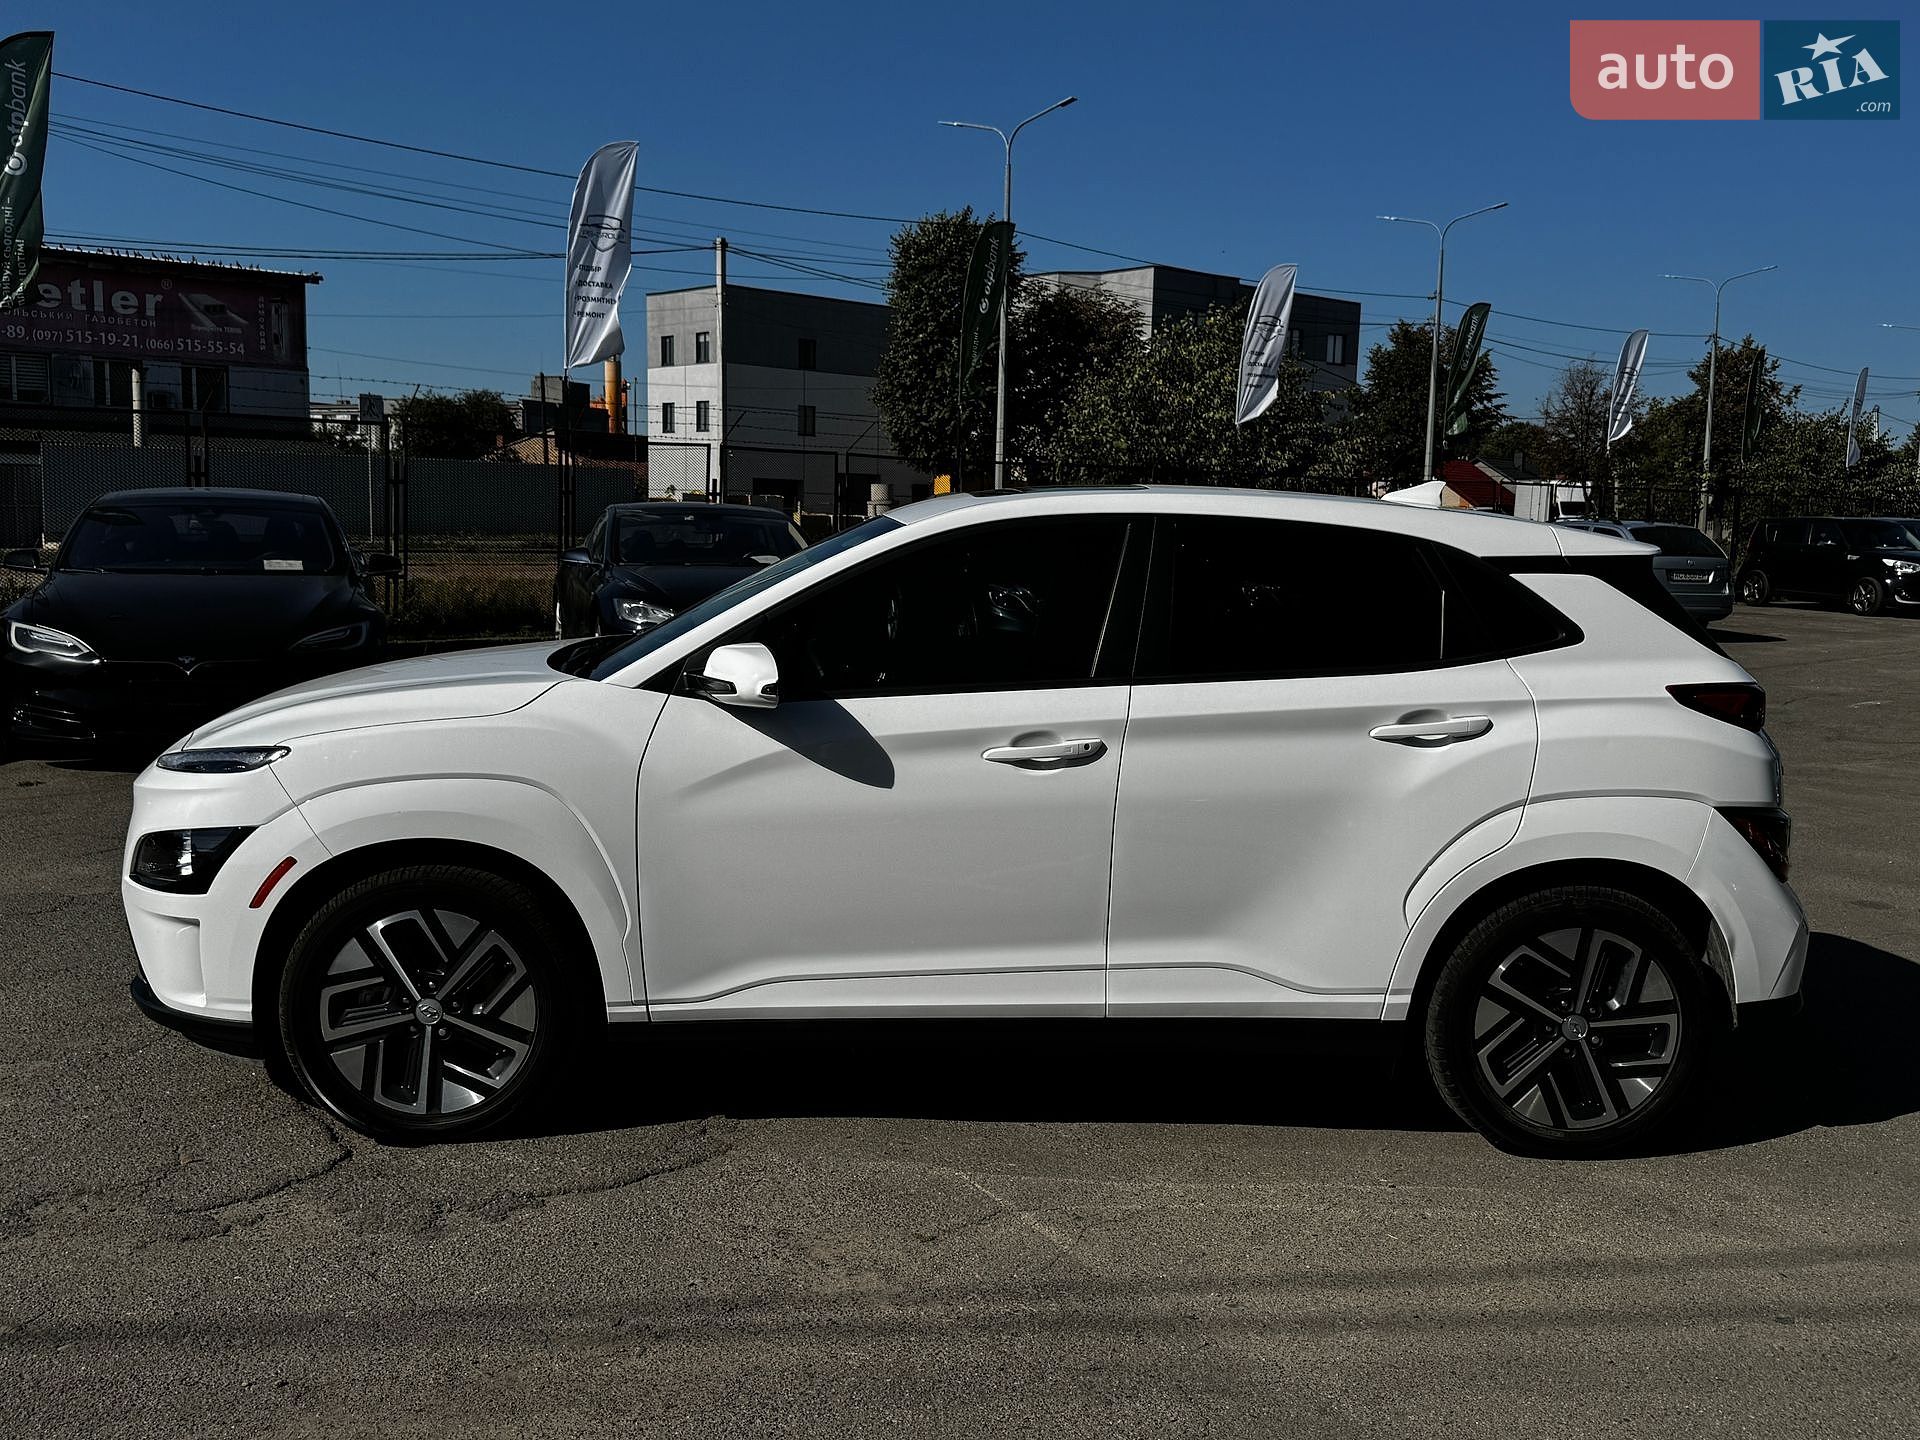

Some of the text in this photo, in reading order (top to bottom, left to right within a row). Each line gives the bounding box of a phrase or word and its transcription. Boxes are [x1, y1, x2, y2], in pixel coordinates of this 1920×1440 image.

[37, 279, 164, 317] etler
[32, 328, 63, 343] (097)
[176, 338, 246, 355] 515-55-54
